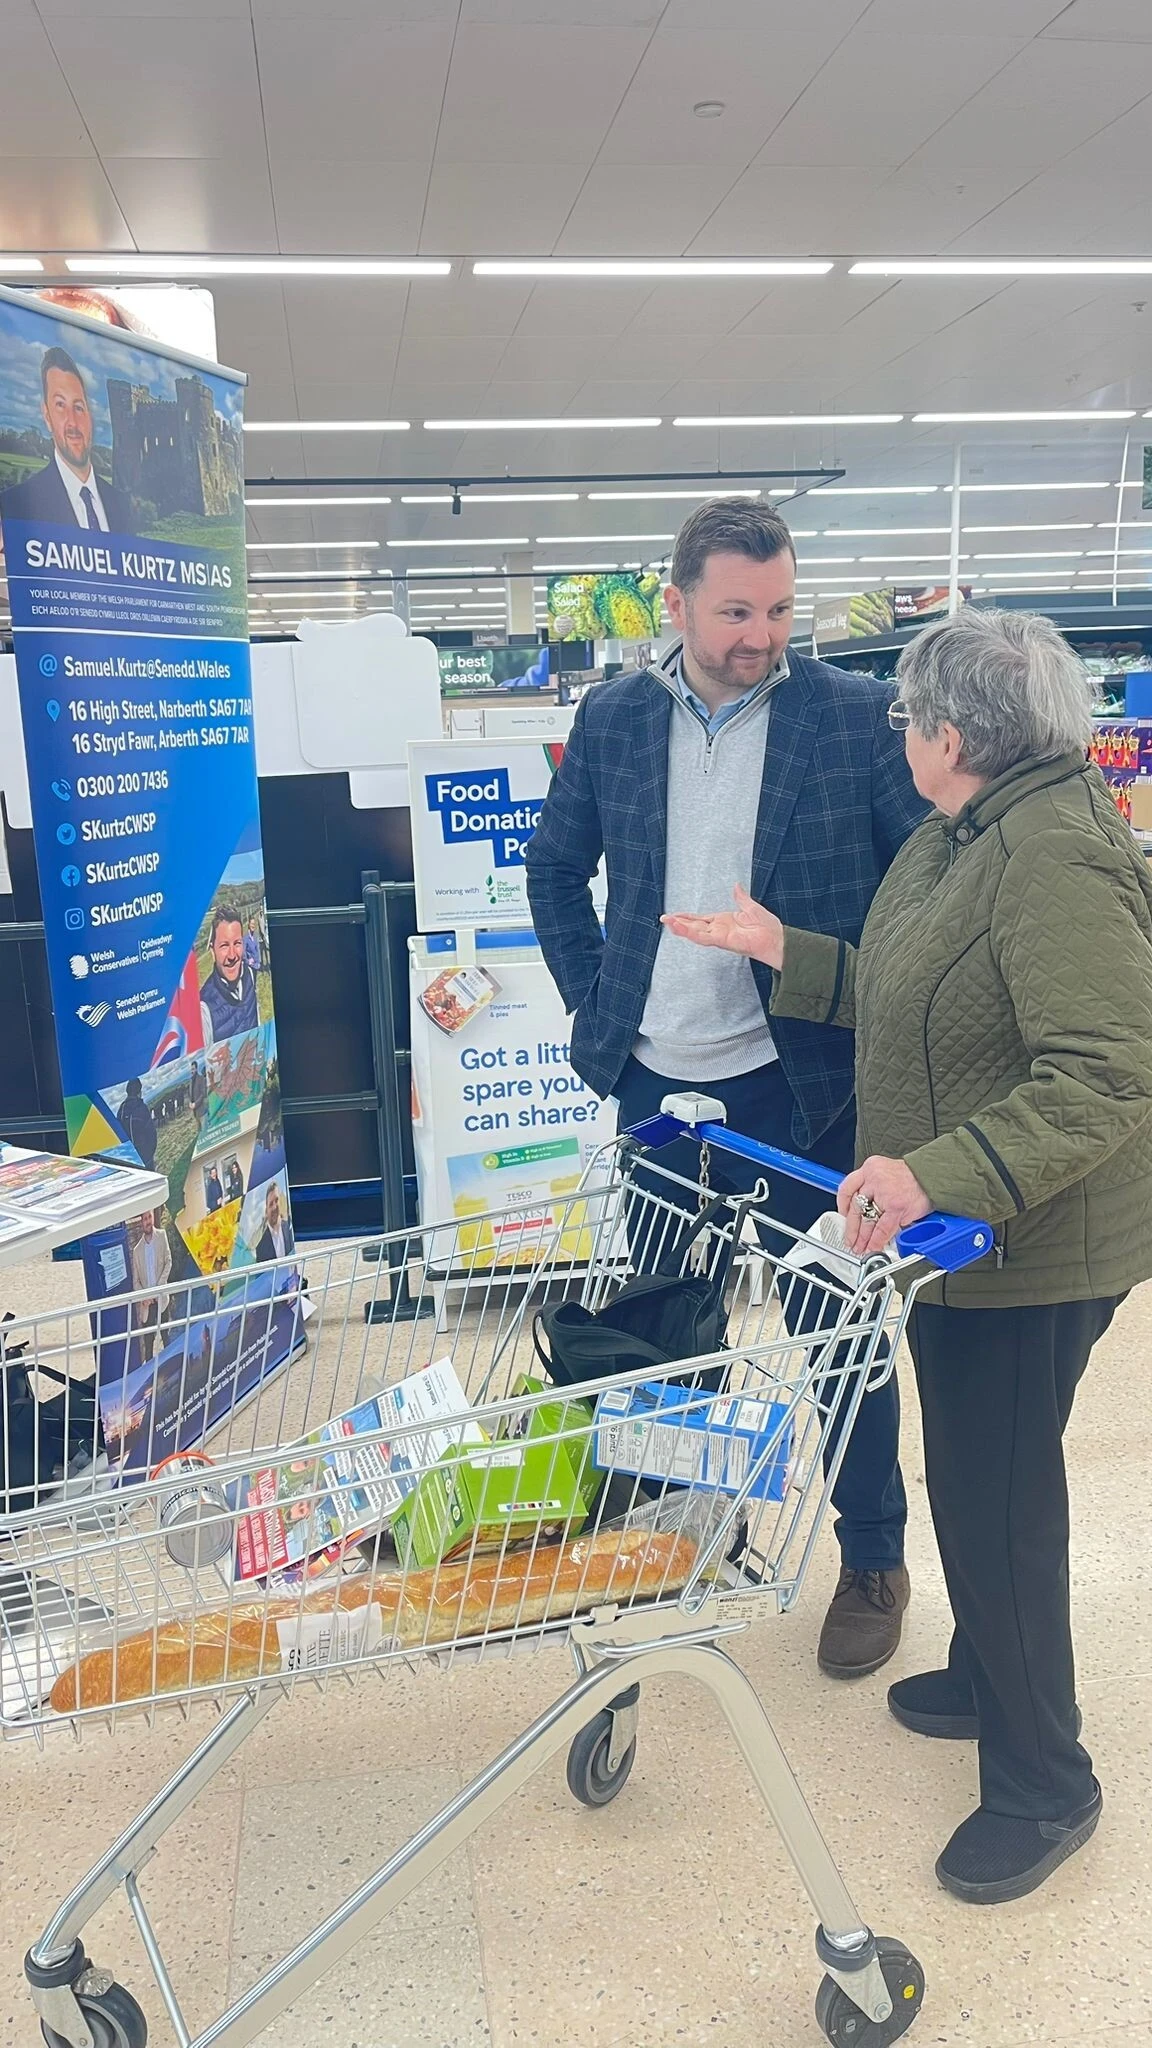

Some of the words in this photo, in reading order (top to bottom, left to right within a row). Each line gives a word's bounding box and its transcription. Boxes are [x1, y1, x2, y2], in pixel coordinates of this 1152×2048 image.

[26, 539, 118, 576] SAMUEL
[121, 555, 177, 584] KURTZ
[30, 589, 50, 598] YOUR
[50, 590, 70, 600] LOCAL
[554, 582, 585, 593] Salad
[32, 606, 48, 615] EICH
[49, 606, 69, 616] AELOD
[555, 598, 580, 607] Salad
[895, 605, 917, 613] heese
[64, 657, 231, 680] Samuel.Kurtz@Senedd.Wales
[440, 658, 454, 669] ur
[457, 656, 486, 668] best
[444, 673, 491, 684] season
[69, 701, 87, 722] 16
[89, 700, 119, 725] High
[122, 700, 158, 721] Street,
[159, 698, 207, 719] Narberth
[209, 698, 236, 717] SA67
[72, 733, 90, 754] 16
[93, 730, 126, 757] Stryd
[128, 730, 157, 751] Fawr,
[158, 730, 199, 749] Arberth
[201, 727, 229, 746] SA67
[231, 726, 249, 744] 7AR
[77, 776, 116, 799] 0300
[117, 772, 140, 795] 200
[141, 770, 169, 792] 7436
[436, 779, 500, 802] Food
[81, 812, 156, 843] SKurtzCWSP
[450, 806, 542, 834] Donatio
[504, 837, 528, 860] Po
[86, 852, 160, 884] SKurtzCWSP
[435, 887, 463, 896] Working
[90, 891, 163, 928] SKurtzCWSP
[90, 950, 115, 964] Welsh
[92, 953, 139, 975] Conservatives
[142, 947, 164, 962] Cymreig
[115, 993, 138, 1009] Senedd
[139, 988, 158, 1004] Cymru
[117, 1007, 136, 1021] Welsh
[136, 997, 165, 1016] Parliament
[460, 1047, 508, 1070] Got
[515, 1048, 529, 1065] a
[538, 1042, 570, 1064] litt
[463, 1078, 533, 1106] spare
[539, 1076, 585, 1100] you
[464, 1113, 509, 1132] can
[518, 1100, 600, 1128] share?
[506, 1190, 532, 1199] TESCO
[609, 1433, 617, 1453] pints
[258, 1468, 276, 1506] OSPITAL
[306, 1642, 317, 1666] ITE
